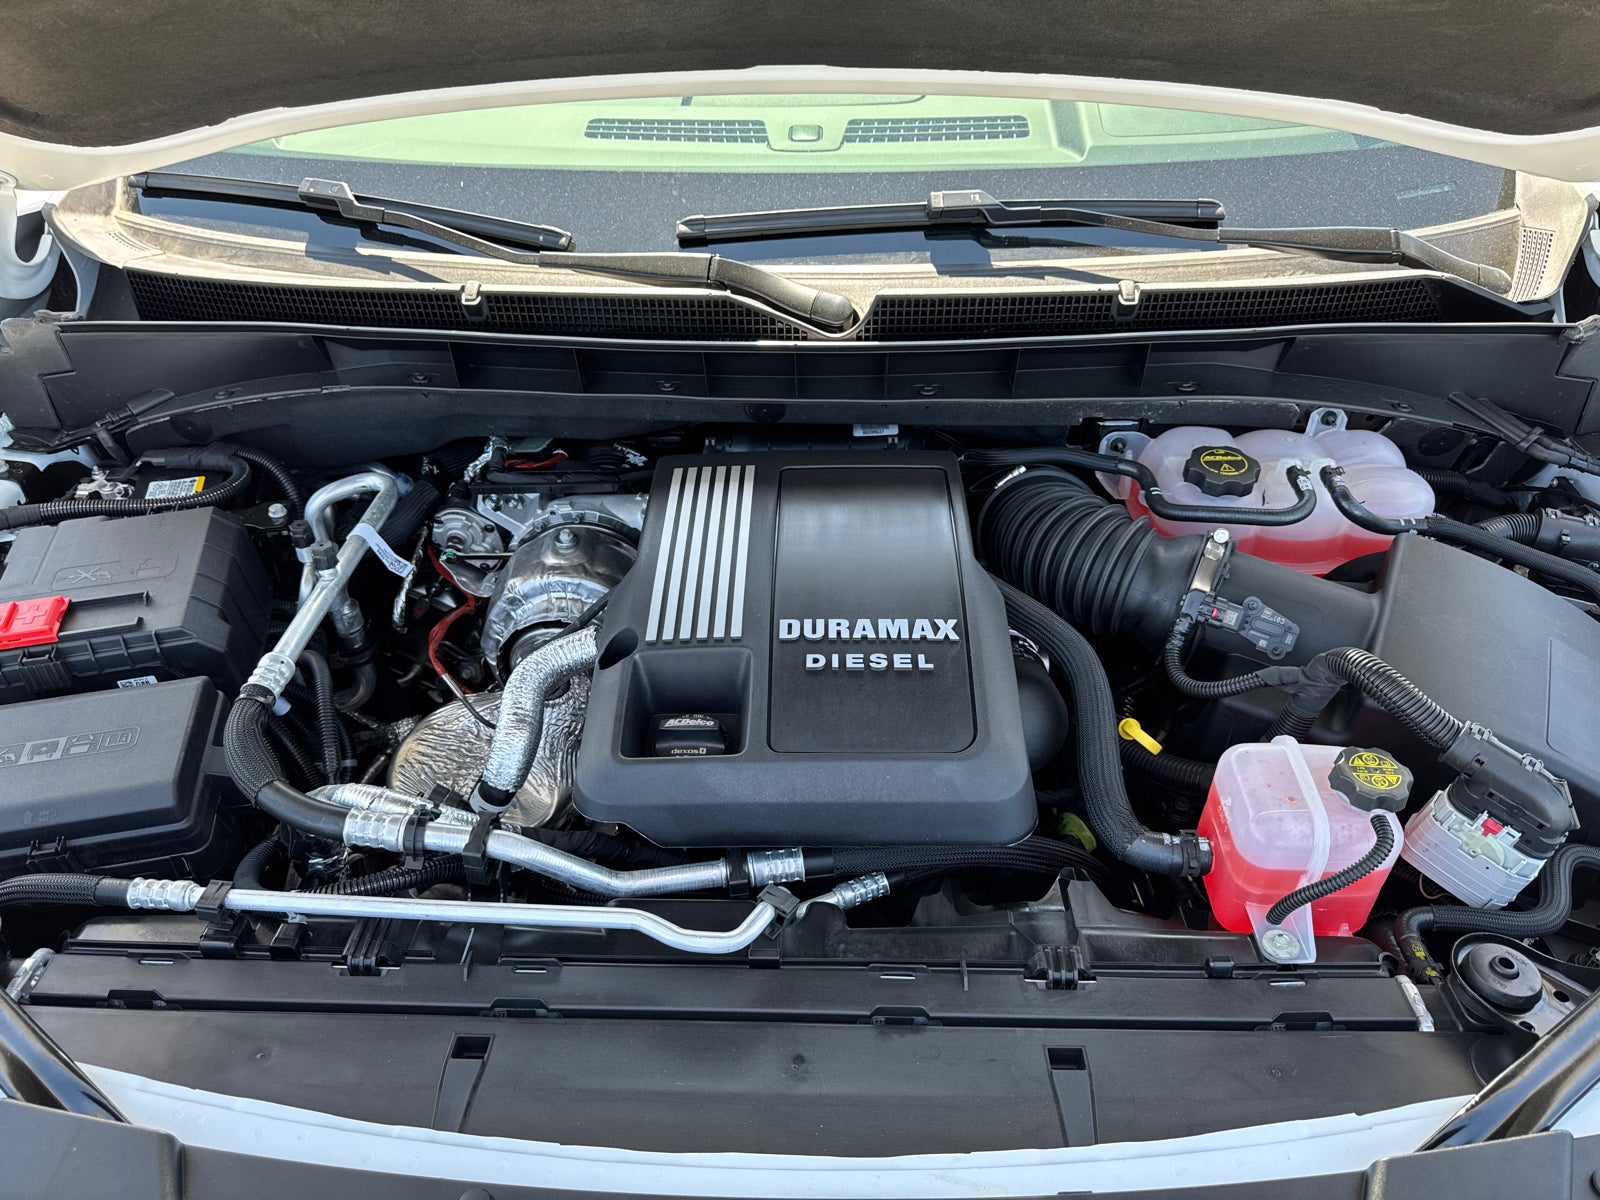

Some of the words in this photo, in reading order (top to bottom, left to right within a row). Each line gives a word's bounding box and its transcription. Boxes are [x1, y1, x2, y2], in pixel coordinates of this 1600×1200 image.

[778, 618, 961, 642] DURAMAX
[805, 653, 935, 671] DIESEL
[663, 718, 715, 728] ACDelco
